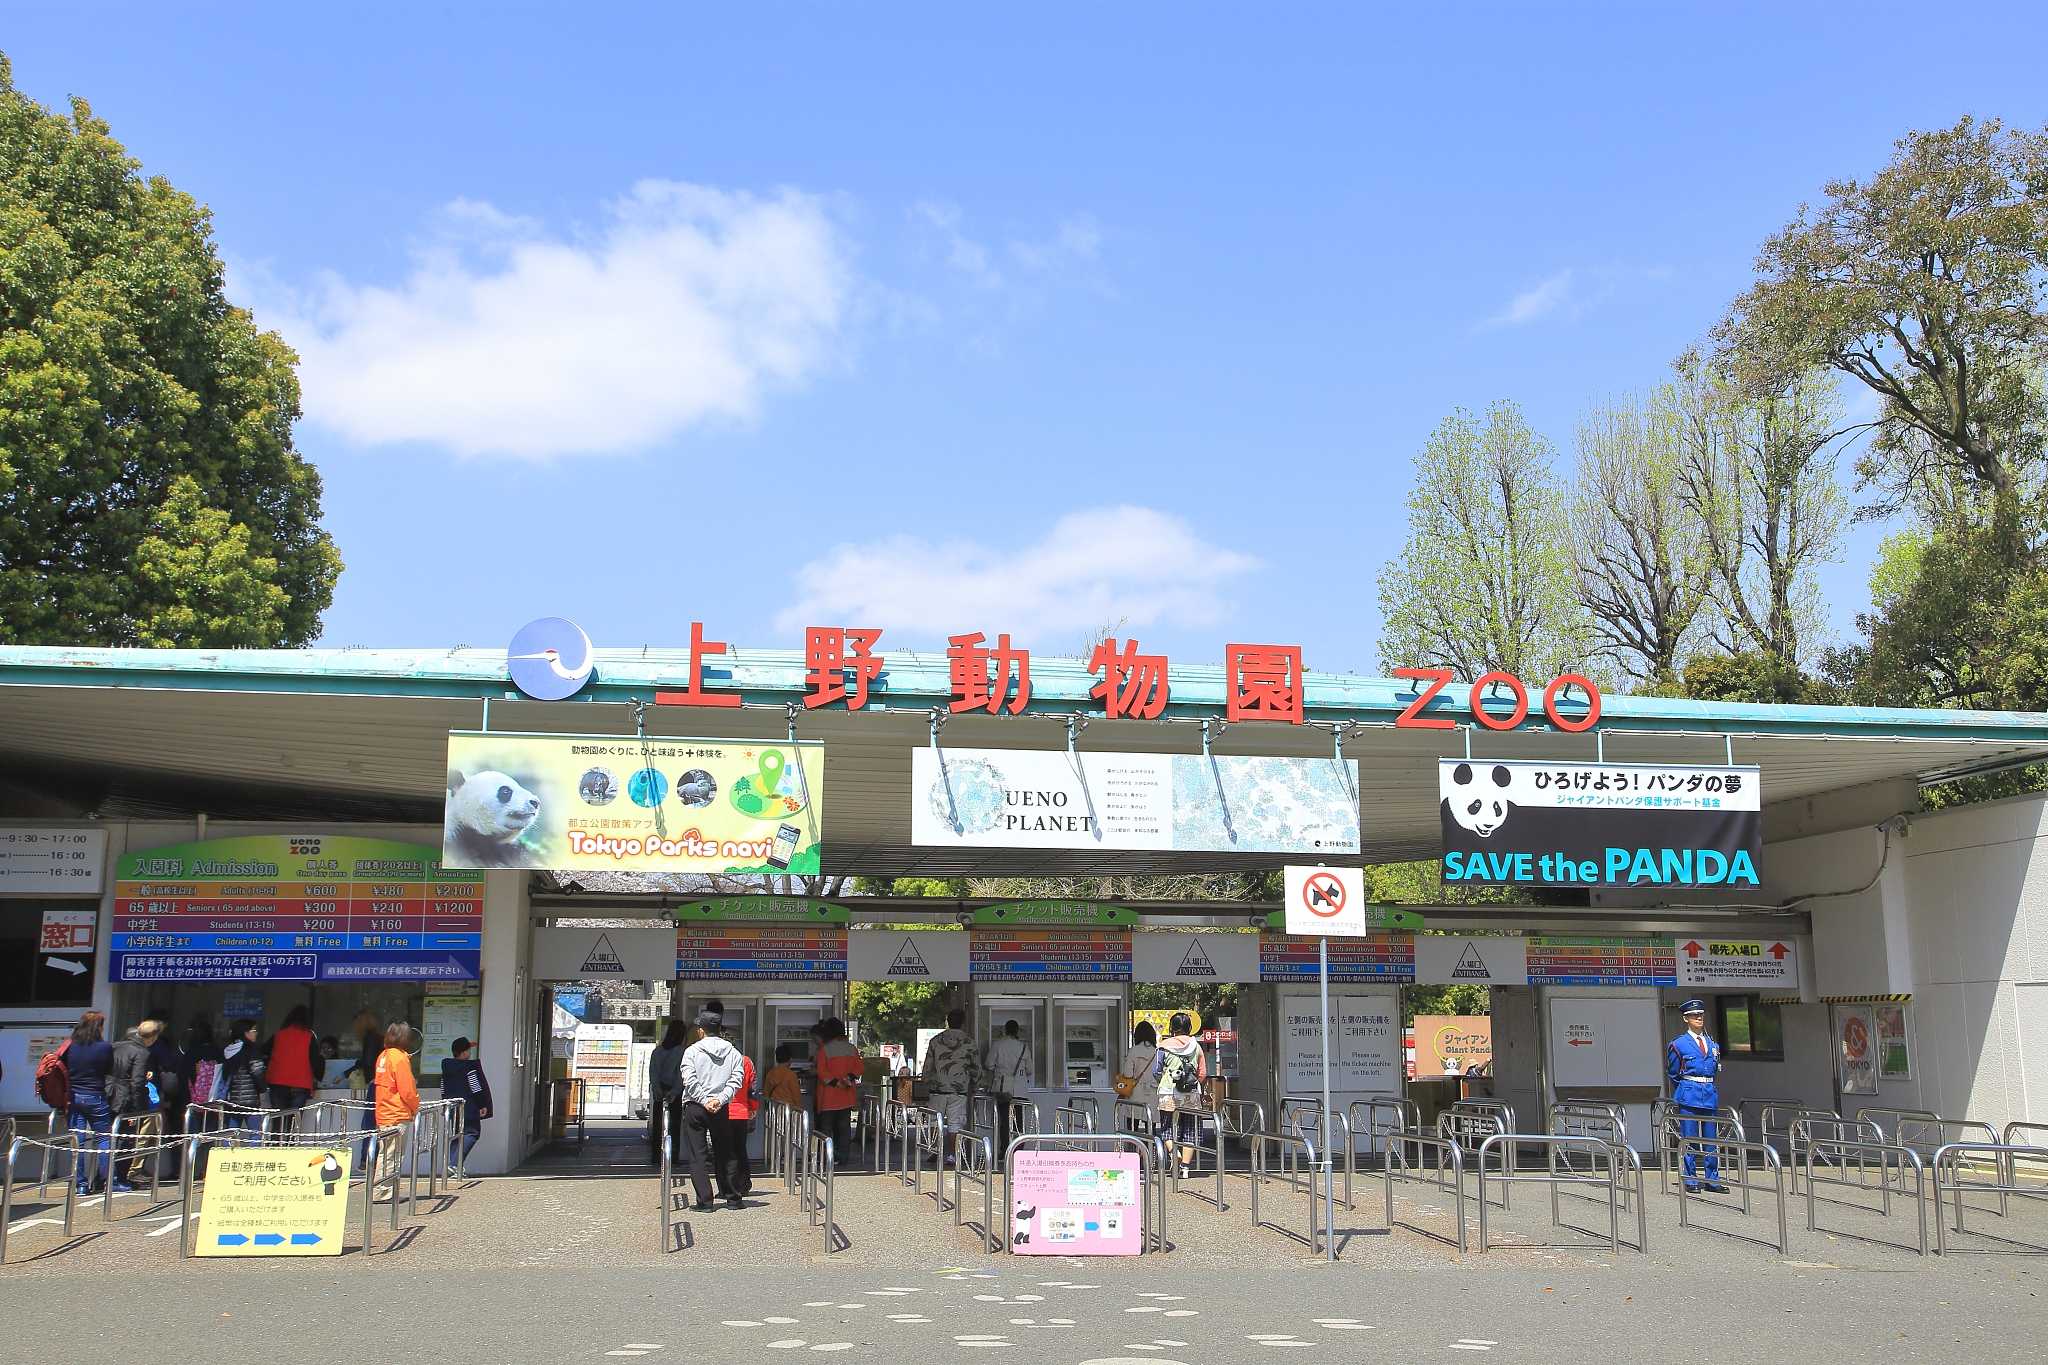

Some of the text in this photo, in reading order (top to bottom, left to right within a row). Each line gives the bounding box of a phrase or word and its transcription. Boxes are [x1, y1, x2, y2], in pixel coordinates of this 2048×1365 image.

[655, 622, 1601, 733] 上野動物園 ZOO
[1648, 773, 1742, 793] パンダの夢
[1005, 789, 1068, 808] UENO
[1556, 794, 1721, 808] ジャイアントパンダ保護サポート基金
[1005, 814, 1094, 833] PLANET
[568, 831, 773, 860] Tokyo Parks navi
[133, 859, 279, 877] 入園料 Admission
[1445, 847, 1760, 885] SAVE the PANDA
[304, 885, 337, 896] ¥600
[373, 885, 404, 897] ¥480
[186, 903, 215, 913] Seniors
[235, 904, 249, 913] and
[250, 904, 276, 914] above)
[304, 902, 336, 913] ¥300
[372, 902, 403, 913] ¥240
[435, 902, 473, 913] ¥1200
[719, 898, 809, 913] チケット販売機
[1011, 903, 1100, 917] チケット販売機
[128, 919, 402, 931] 中学生 Students (13-15) ¥200 ¥160
[41, 922, 95, 949] 窓口
[215, 937, 248, 946] Children
[250, 937, 274, 947] (0-12)
[295, 936, 314, 947] 無料
[318, 937, 341, 946] Free
[363, 936, 381, 947] 無料
[385, 937, 409, 946] Free
[818, 951, 838, 960] ¥200
[1710, 944, 1760, 956] 優先入場口
[1104, 953, 1124, 961] ¥200
[327, 966, 461, 976] 直接改札口でお手帳をご提示下さい
[583, 963, 622, 971] ENTRANCE
[890, 966, 927, 974] ENTRANCE
[1179, 967, 1214, 975] ENTRANCE
[126, 968, 271, 979] 都内在住在学の中学生は無料です
[1287, 1015, 1337, 1025] 左側の販売を
[1345, 1027, 1387, 1037] ご利用下さい
[1351, 1051, 1369, 1059] Please
[220, 1161, 288, 1173] 自動券売機も
[233, 1175, 312, 1187] ご利用ください
